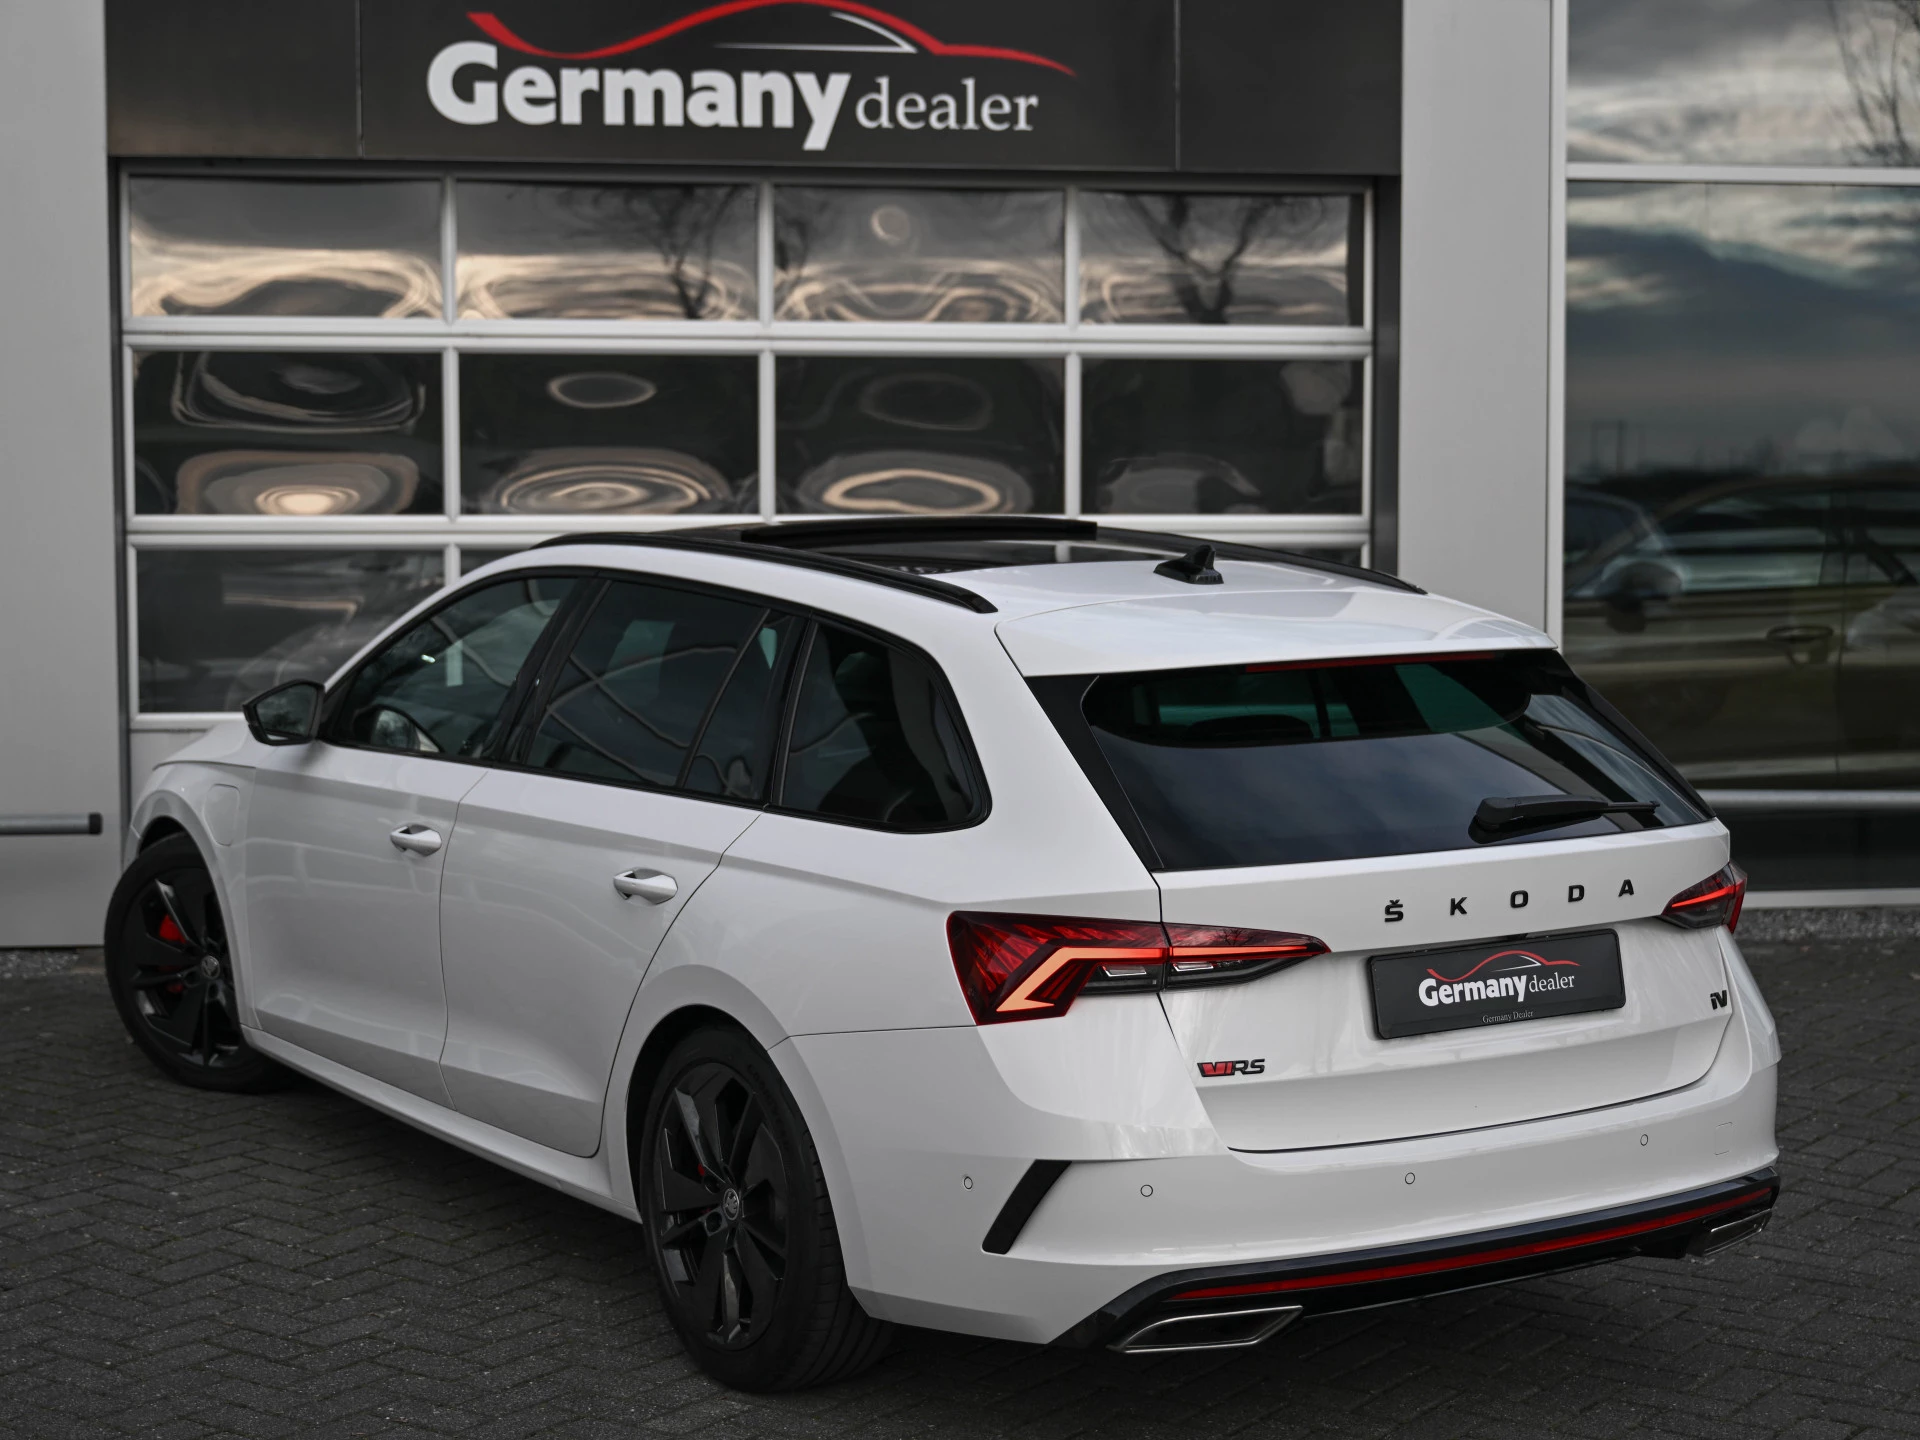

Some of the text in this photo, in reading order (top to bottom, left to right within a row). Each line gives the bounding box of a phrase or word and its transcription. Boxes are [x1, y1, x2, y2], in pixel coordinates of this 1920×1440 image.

[427, 41, 1039, 151] Germany dealer
[1384, 879, 1635, 922] ŠKODA
[1418, 972, 1575, 1007] Germany dealer
[1482, 1010, 1534, 1023] Germany Dealer
